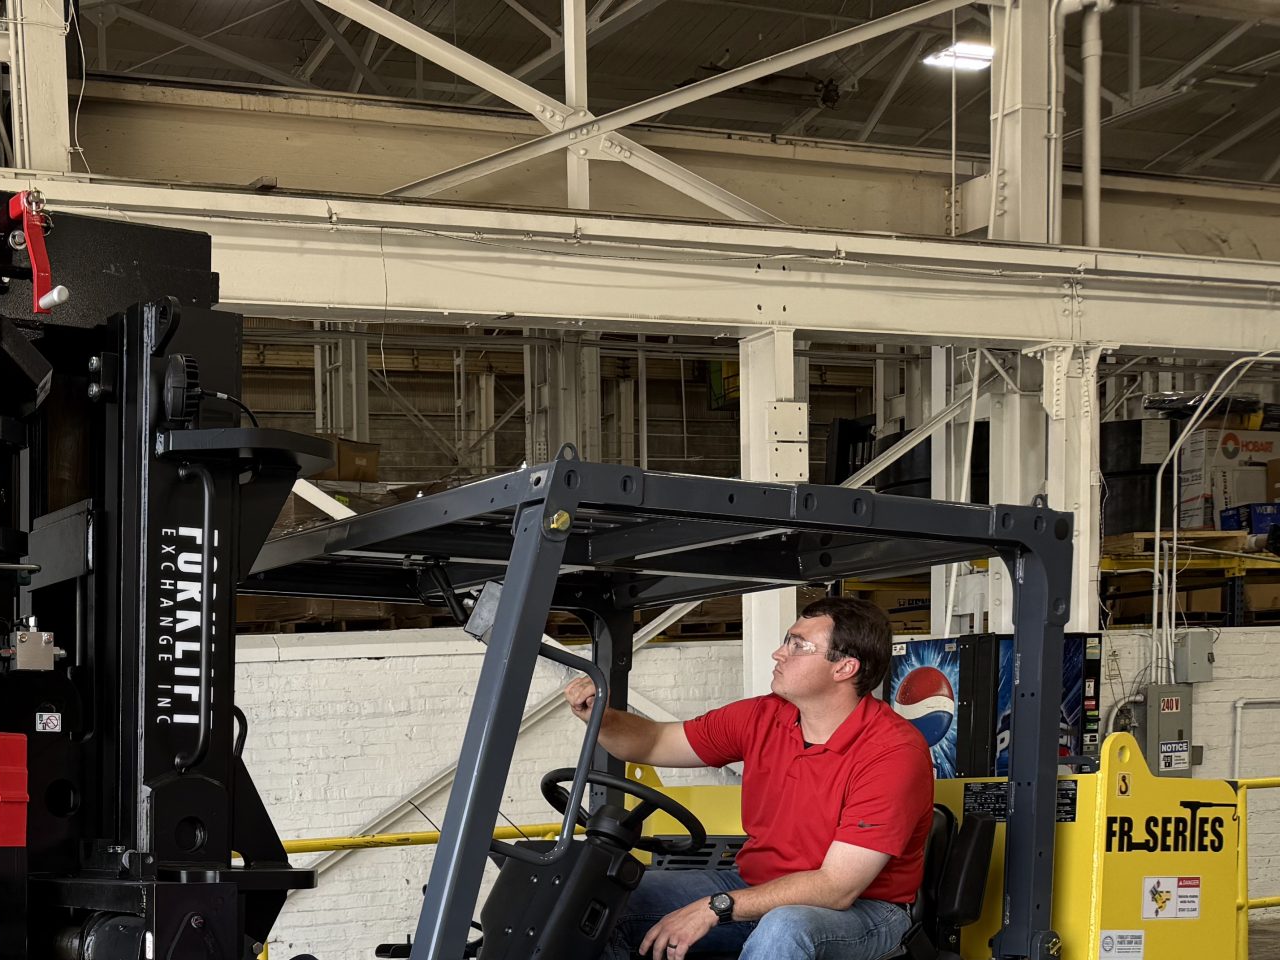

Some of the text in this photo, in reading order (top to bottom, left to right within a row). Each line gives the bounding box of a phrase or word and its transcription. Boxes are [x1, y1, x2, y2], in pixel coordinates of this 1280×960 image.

[1241, 441, 1273, 453] HOBART
[157, 528, 176, 724] EXCHANGE INC
[1162, 698, 1180, 711] 240 V
[1161, 743, 1188, 752] NOTICE
[1144, 801, 1224, 852] SERIES
